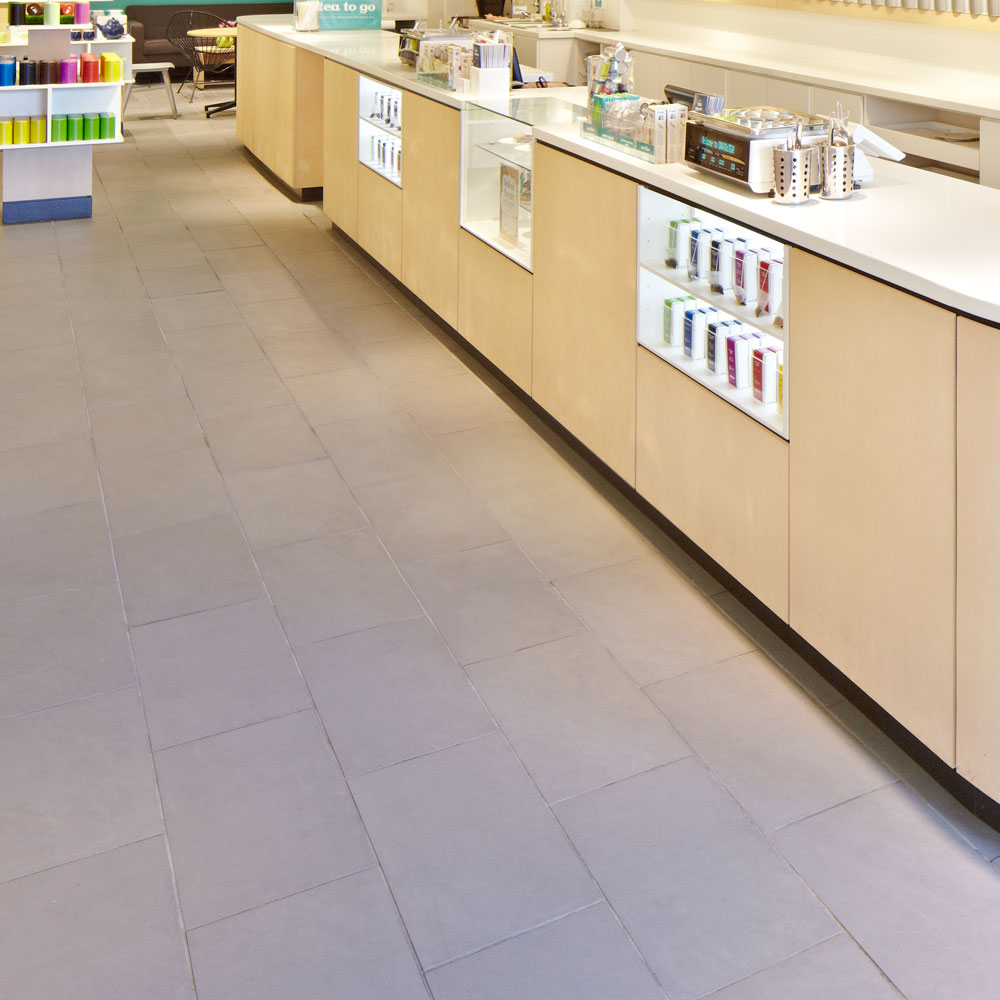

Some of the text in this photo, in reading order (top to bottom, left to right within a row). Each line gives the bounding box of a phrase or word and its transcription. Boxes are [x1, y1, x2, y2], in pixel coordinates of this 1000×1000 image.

[320, 1, 376, 14] tea to go
